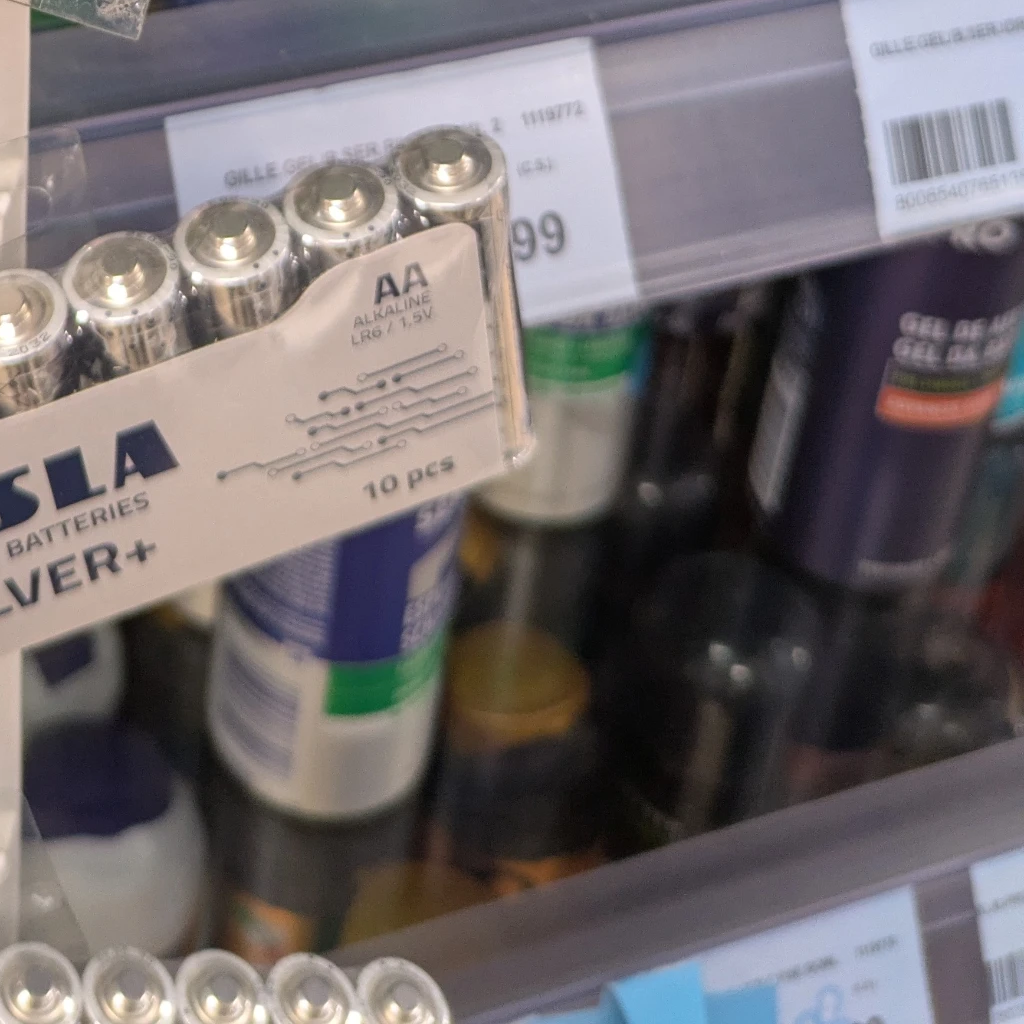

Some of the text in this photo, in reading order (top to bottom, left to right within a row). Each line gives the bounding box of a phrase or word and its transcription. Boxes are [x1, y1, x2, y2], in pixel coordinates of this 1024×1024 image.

[374, 261, 429, 305] AA
[353, 292, 432, 329] ALKALINE
[351, 324, 383, 347] LR6
[362, 456, 456, 501] 10 pcs
[7, 492, 151, 559] BATTERIES
